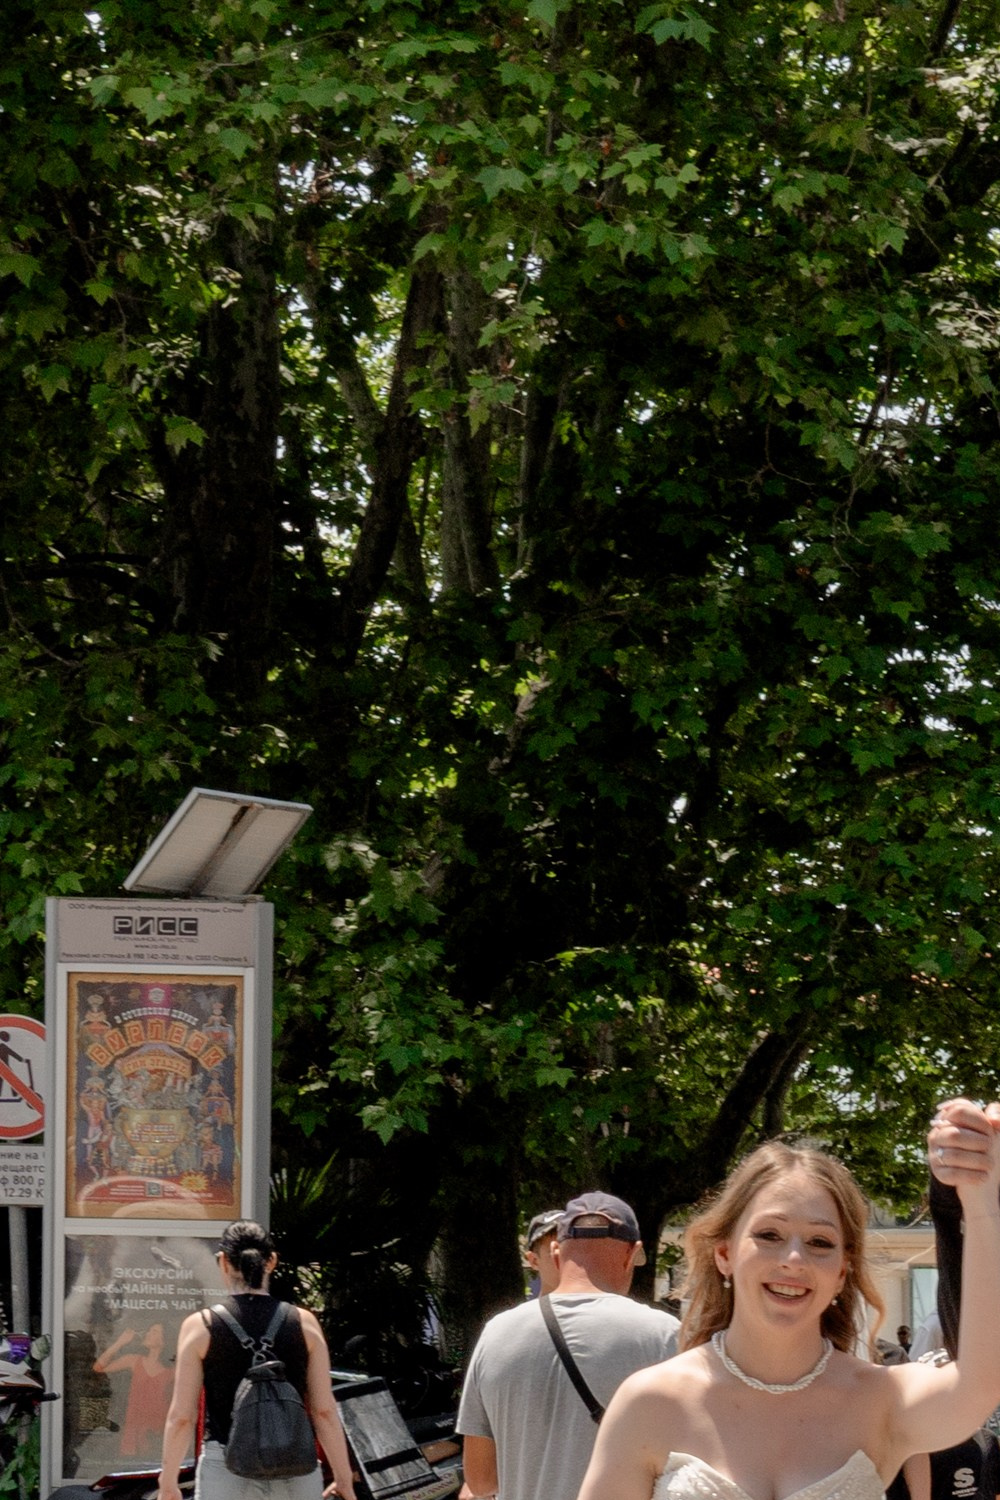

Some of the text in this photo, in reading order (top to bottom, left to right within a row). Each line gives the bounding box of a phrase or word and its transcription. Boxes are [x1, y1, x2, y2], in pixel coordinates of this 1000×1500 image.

[114, 916, 198, 936] РИСС
[88, 1020, 226, 1070] БУРЛЕСК
[25, 1152, 39, 1160] на
[13, 1175, 34, 1185] 800
[4, 1188, 32, 1198] 12.29
[114, 1267, 194, 1280] ЭКСКУРСИИ
[953, 1467, 975, 1488] S
